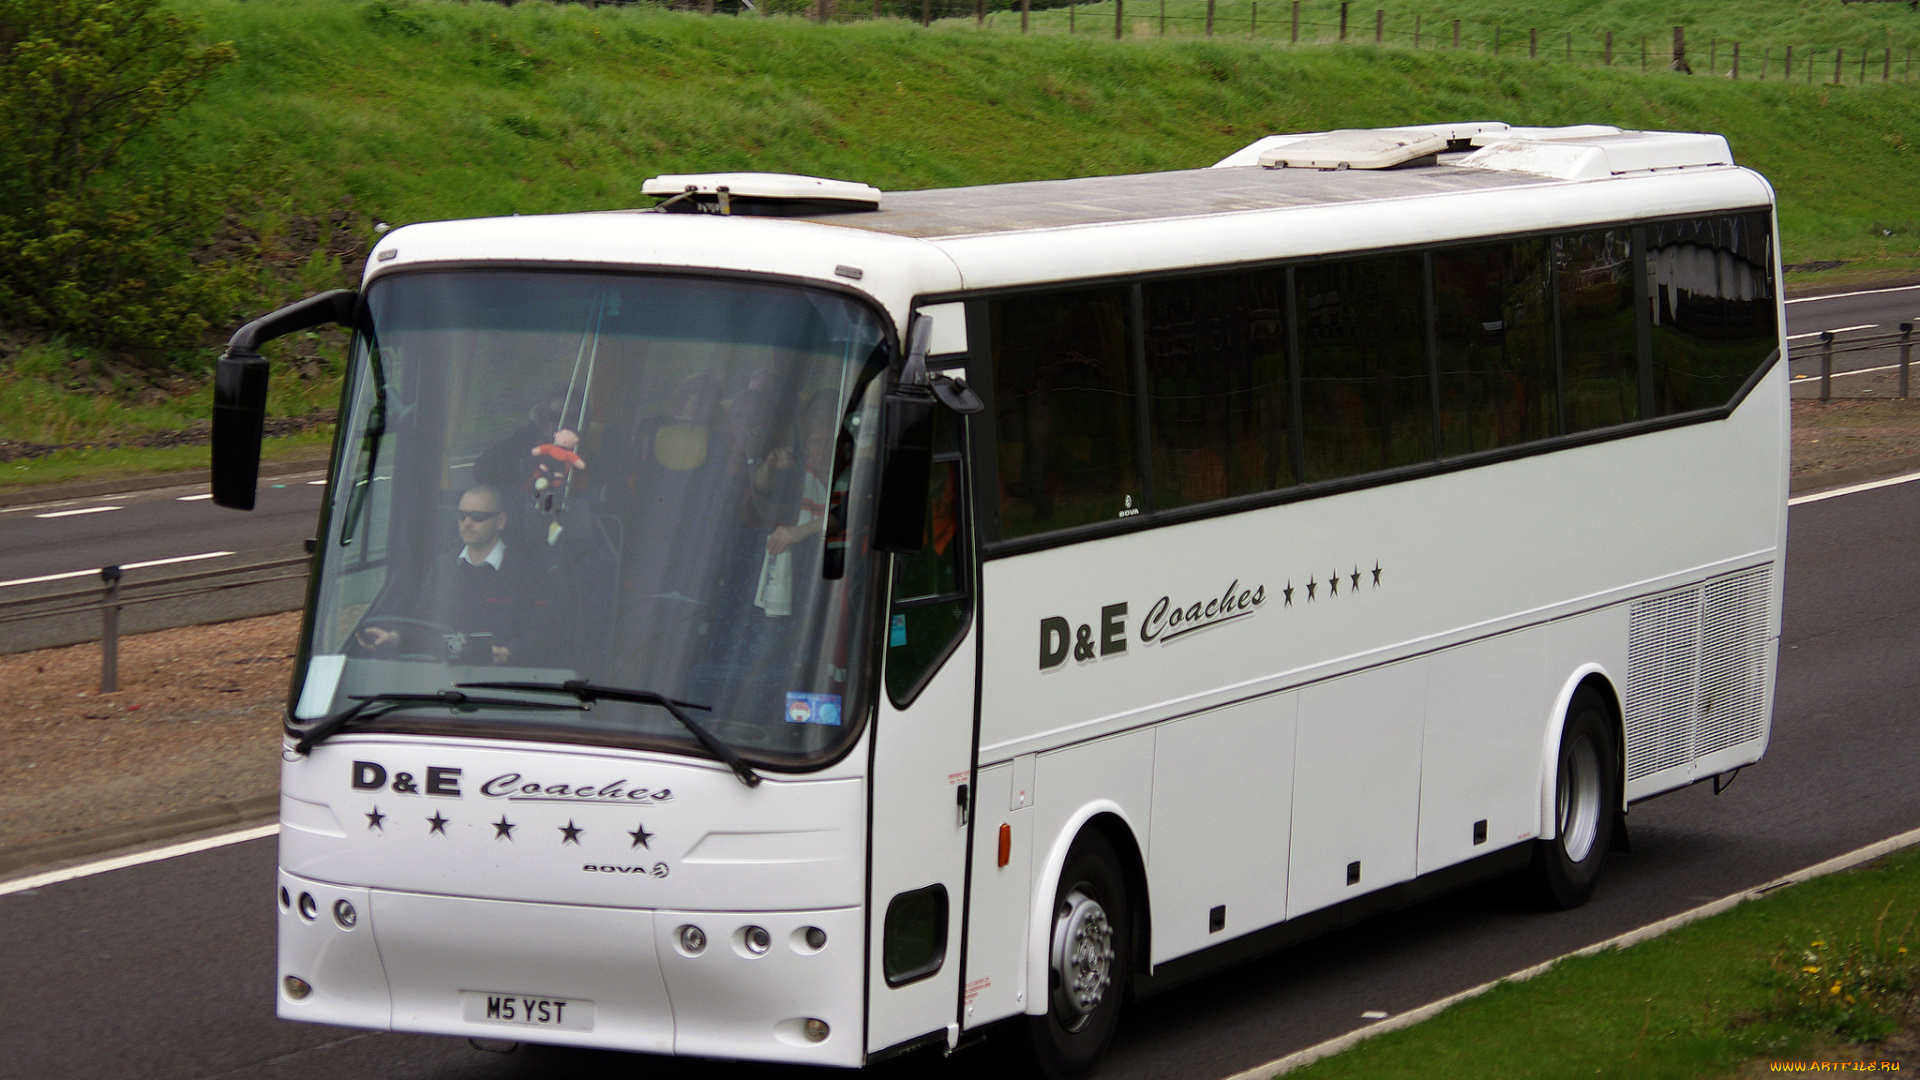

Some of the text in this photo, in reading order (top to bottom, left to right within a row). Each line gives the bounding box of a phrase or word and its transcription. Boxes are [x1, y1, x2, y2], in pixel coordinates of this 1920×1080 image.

[1119, 508, 1140, 518] BOVA
[1039, 578, 1267, 671] D&E Coaches
[351, 760, 676, 802] D&E Coaches
[582, 864, 647, 875] BOVA
[487, 996, 566, 1024] M5 YST
